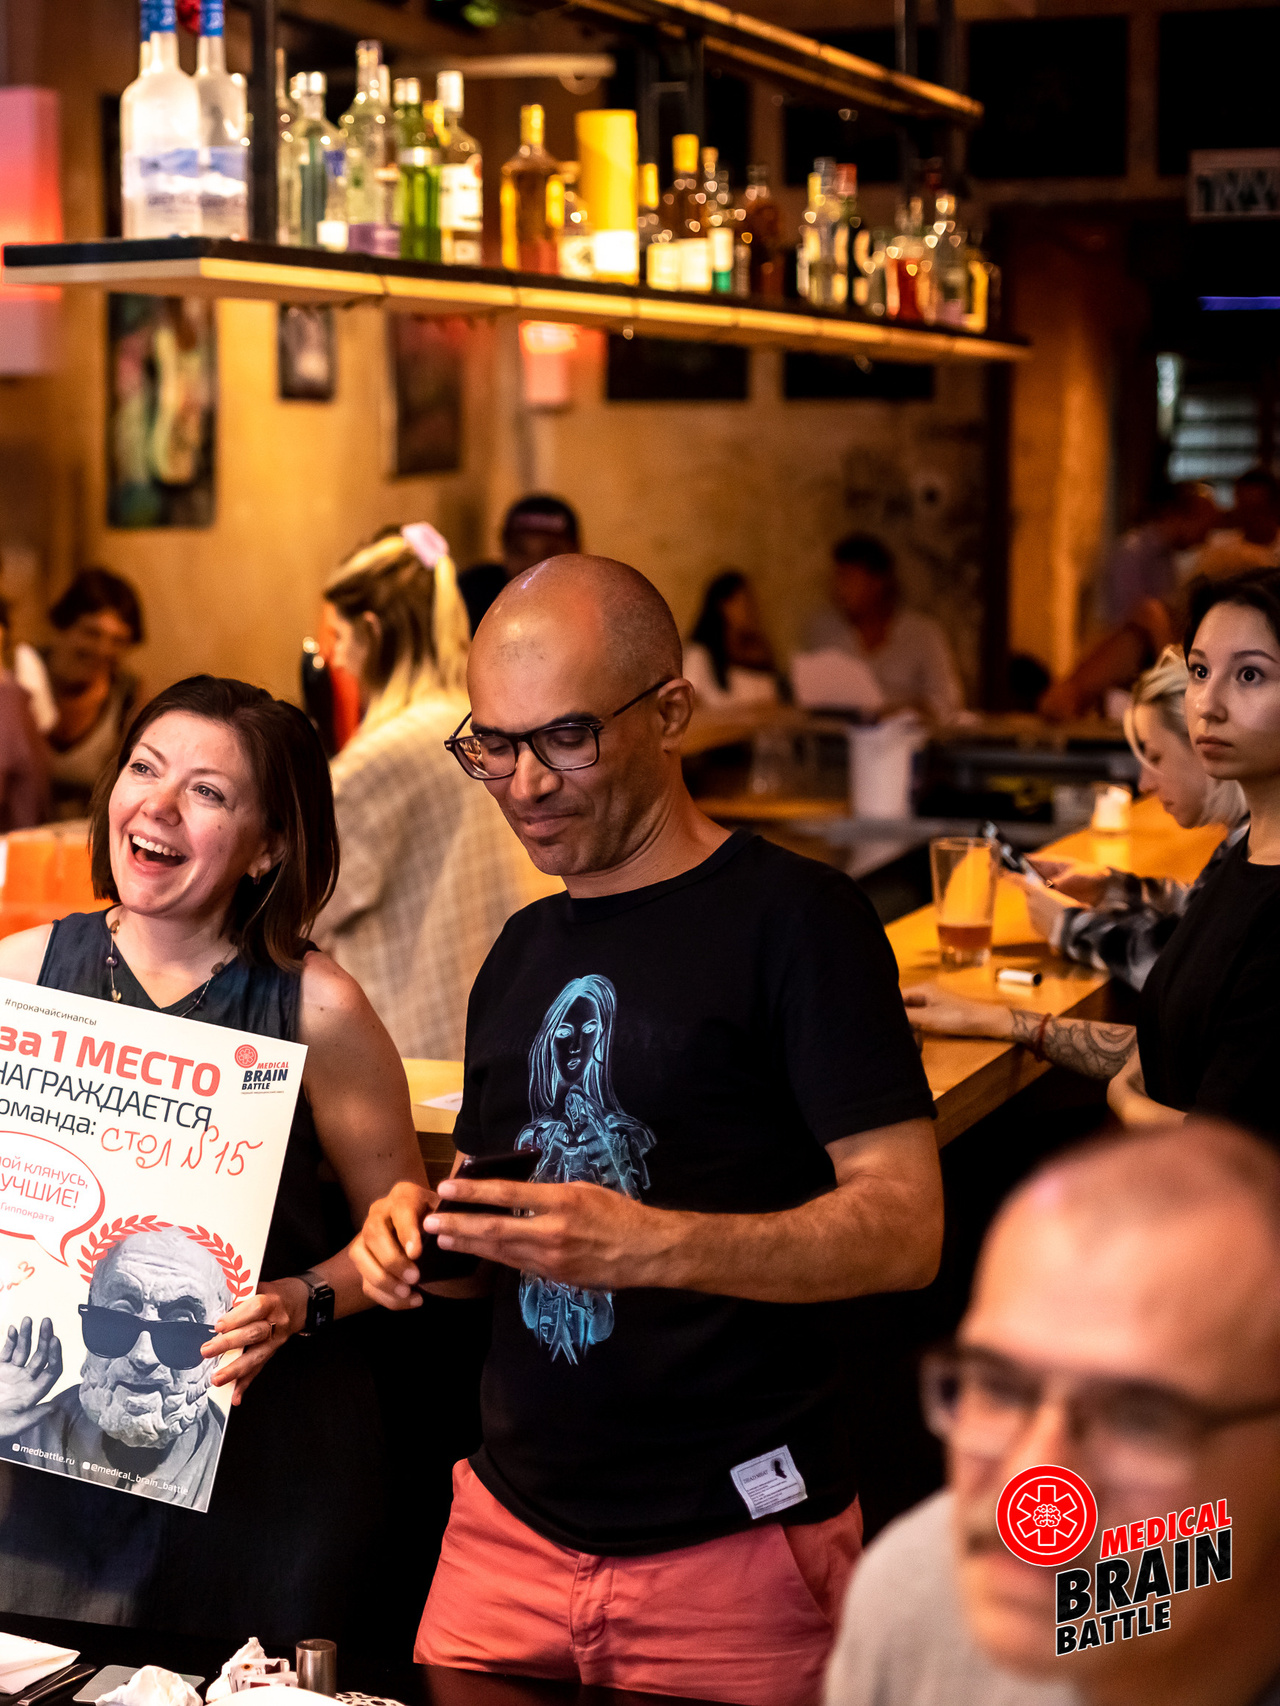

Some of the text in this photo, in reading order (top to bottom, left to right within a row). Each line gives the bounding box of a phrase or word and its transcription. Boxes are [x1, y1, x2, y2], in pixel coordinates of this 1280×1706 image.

[4, 997, 97, 1026] #прокачайсинапсы
[51, 1030, 68, 1063] 1
[75, 1035, 221, 1097] МЕСТО
[256, 1061, 289, 1070] MEDICAL
[241, 1082, 271, 1091] BATTLE
[242, 1069, 289, 1083] BRAIN
[23, 1162, 89, 1189] клянусь,
[0, 1201, 55, 1223] Гиппократа
[20, 1445, 189, 1496] medbattle.ru @medical_brain_battle
